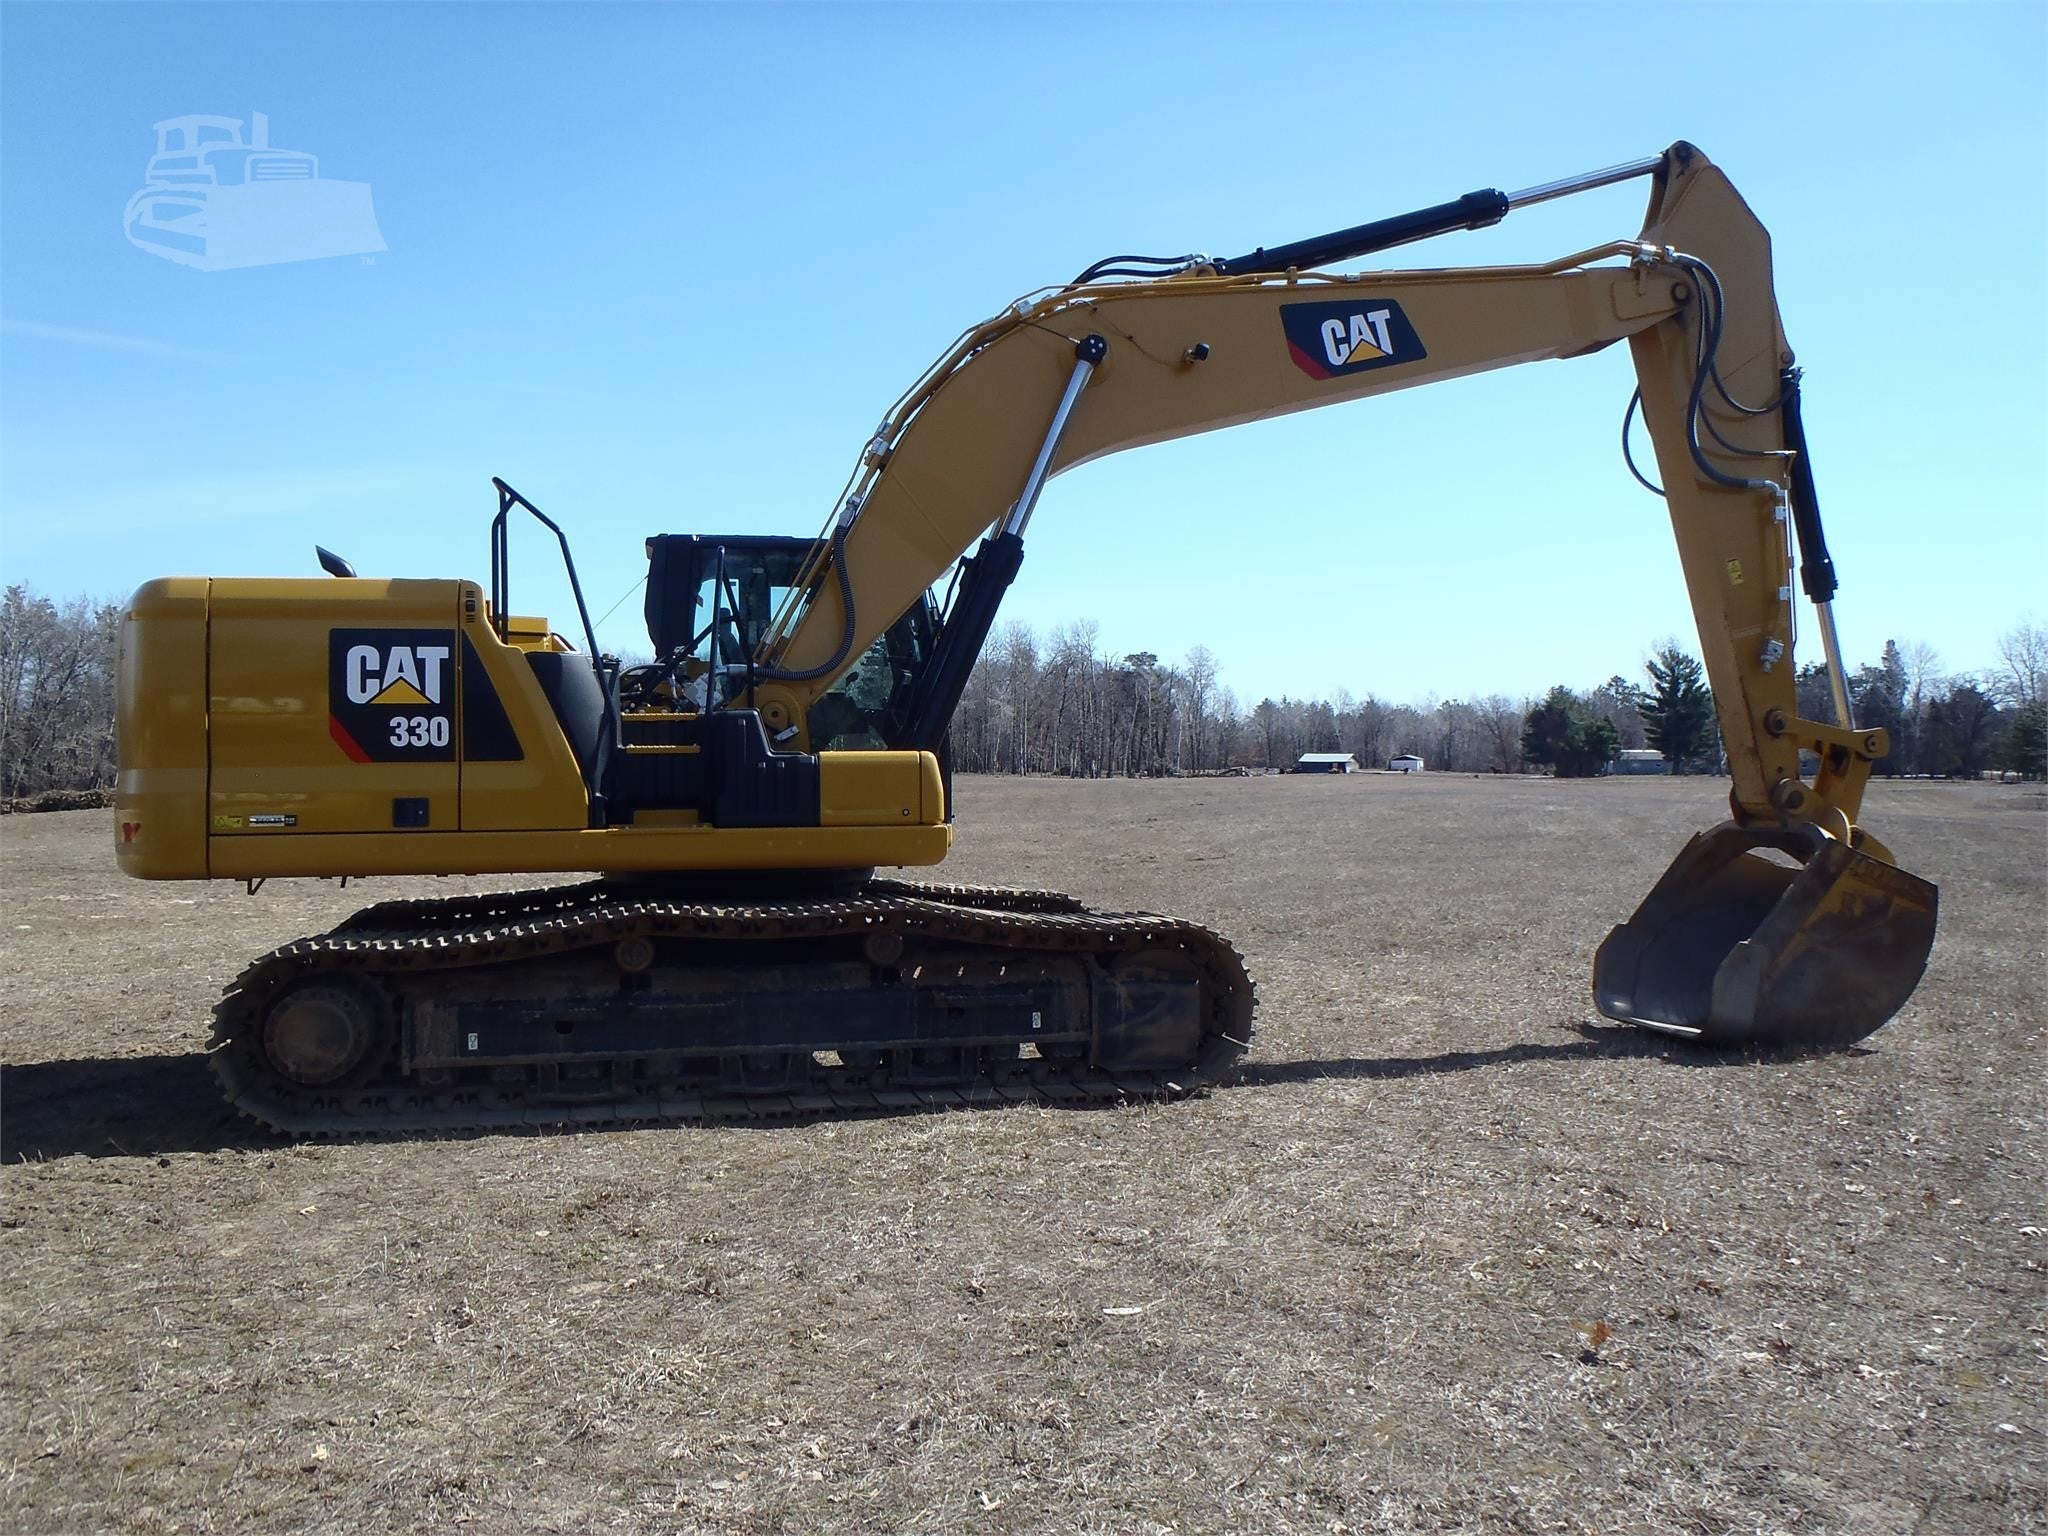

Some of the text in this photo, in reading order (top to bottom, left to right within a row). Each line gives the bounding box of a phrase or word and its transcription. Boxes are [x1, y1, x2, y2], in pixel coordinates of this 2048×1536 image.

[1321, 309, 1393, 366] CAT
[346, 645, 448, 704] CAT
[390, 716, 449, 747] 330
